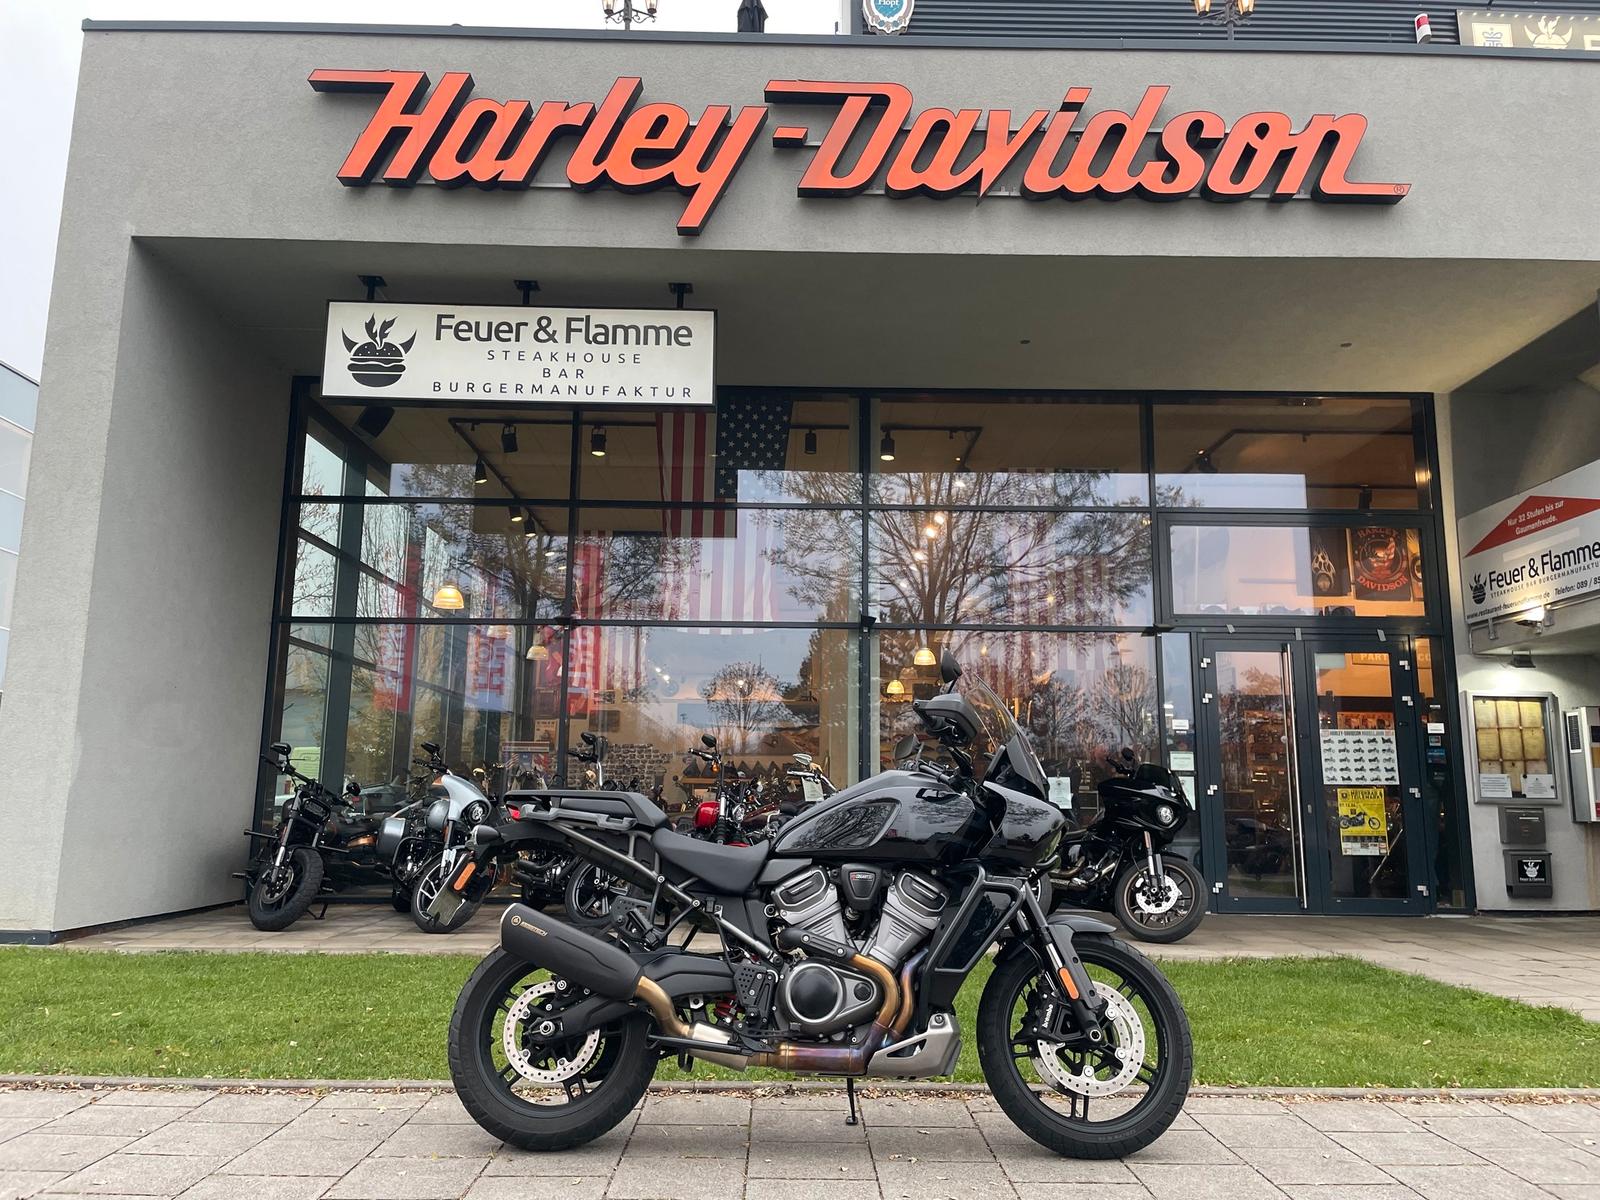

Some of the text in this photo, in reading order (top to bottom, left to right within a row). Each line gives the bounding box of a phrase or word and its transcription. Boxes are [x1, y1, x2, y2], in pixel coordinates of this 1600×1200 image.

[435, 313, 693, 347] Feuer & Flamme
[487, 350, 641, 364] STEAKHOUSE
[542, 367, 585, 379] BAR
[432, 381, 692, 398] BURGERMANUFAKTUR
[1507, 500, 1564, 527] Nur 32 Stufen bis zur
[1488, 541, 1600, 591] Feuer & Flamme
[1356, 575, 1408, 592] DAVIDSON
[1490, 584, 1524, 599] STEAKHOUSE
[1554, 585, 1576, 596] Telefon:
